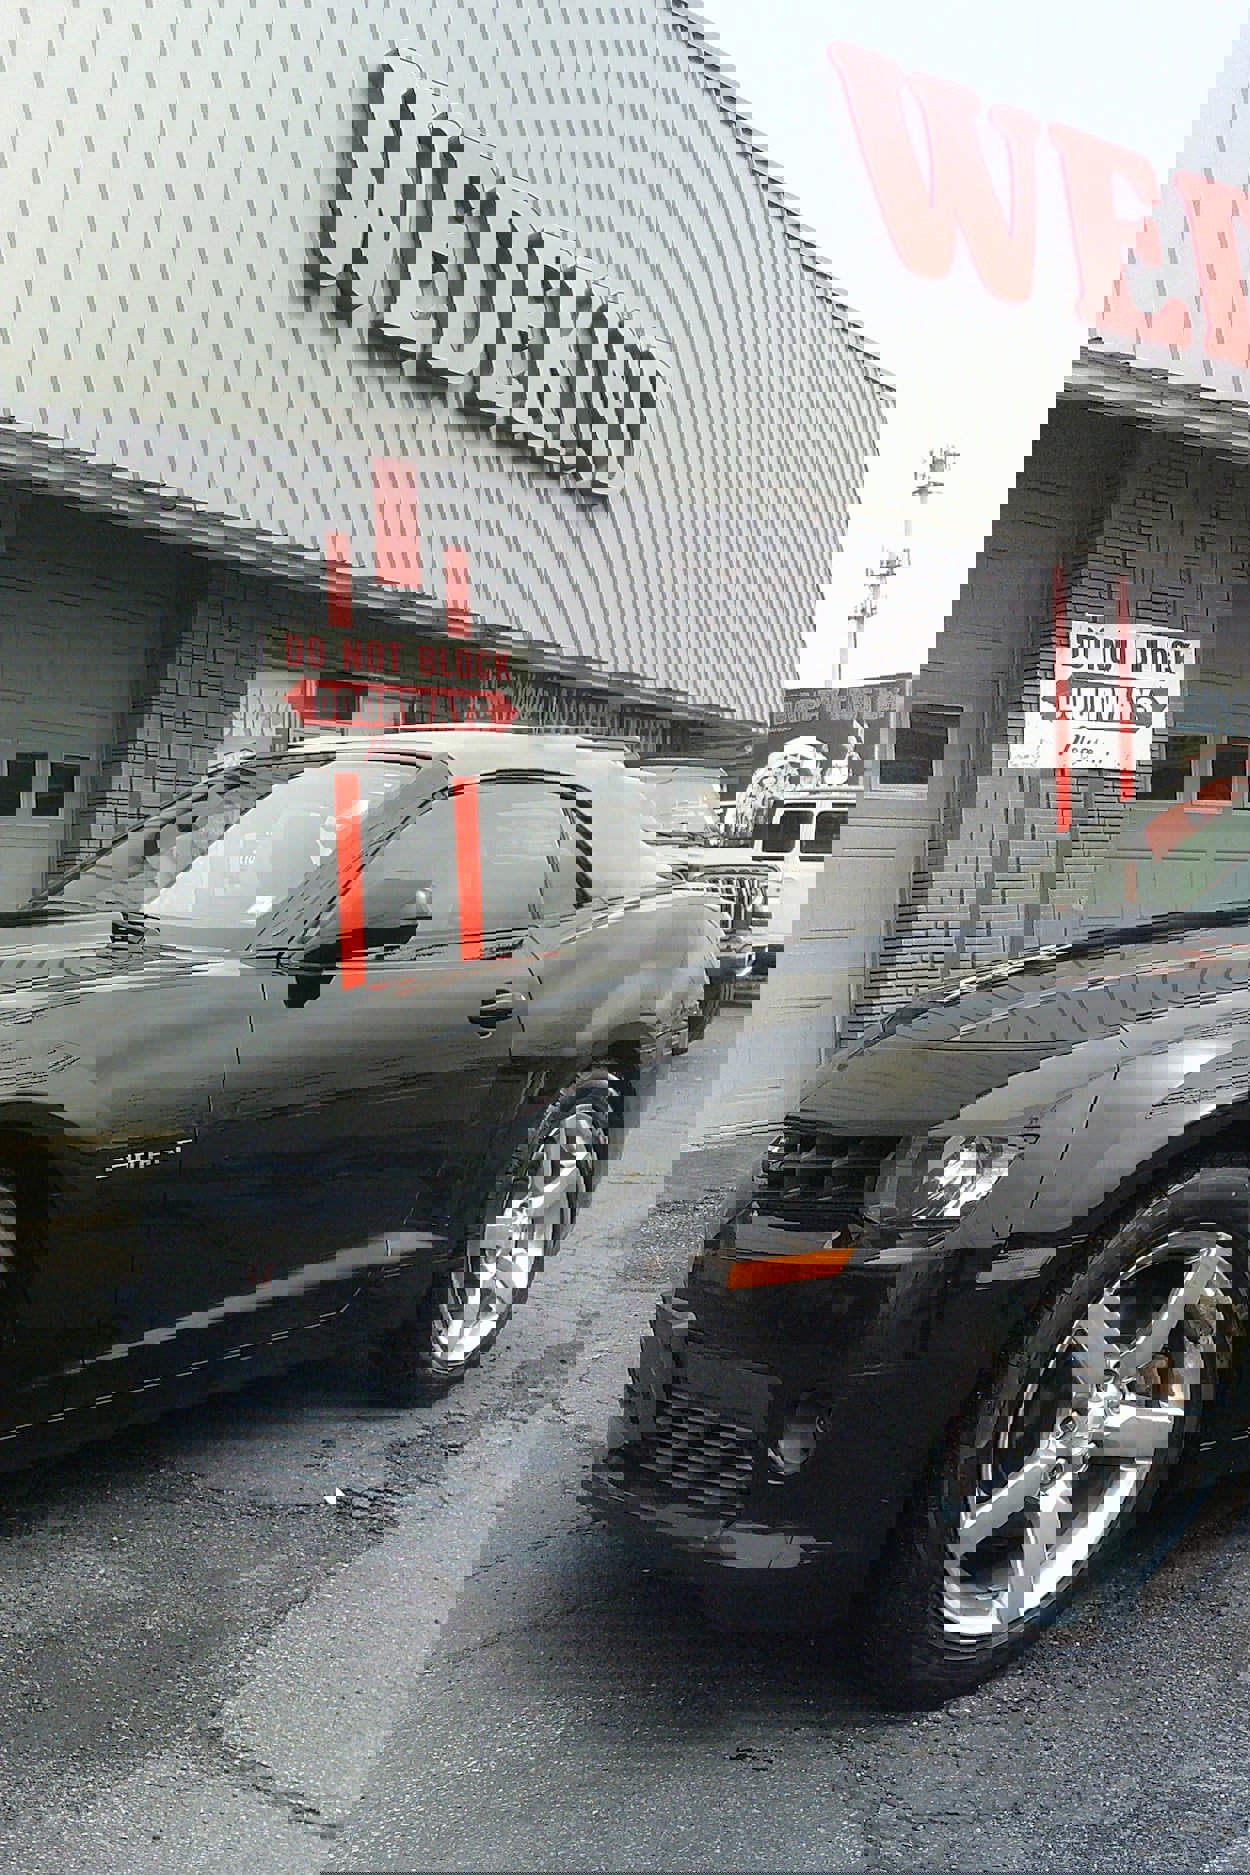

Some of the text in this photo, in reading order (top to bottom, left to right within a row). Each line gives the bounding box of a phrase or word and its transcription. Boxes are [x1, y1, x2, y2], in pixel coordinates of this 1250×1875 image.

[284, 633, 512, 683] DO NOT BLOCK
